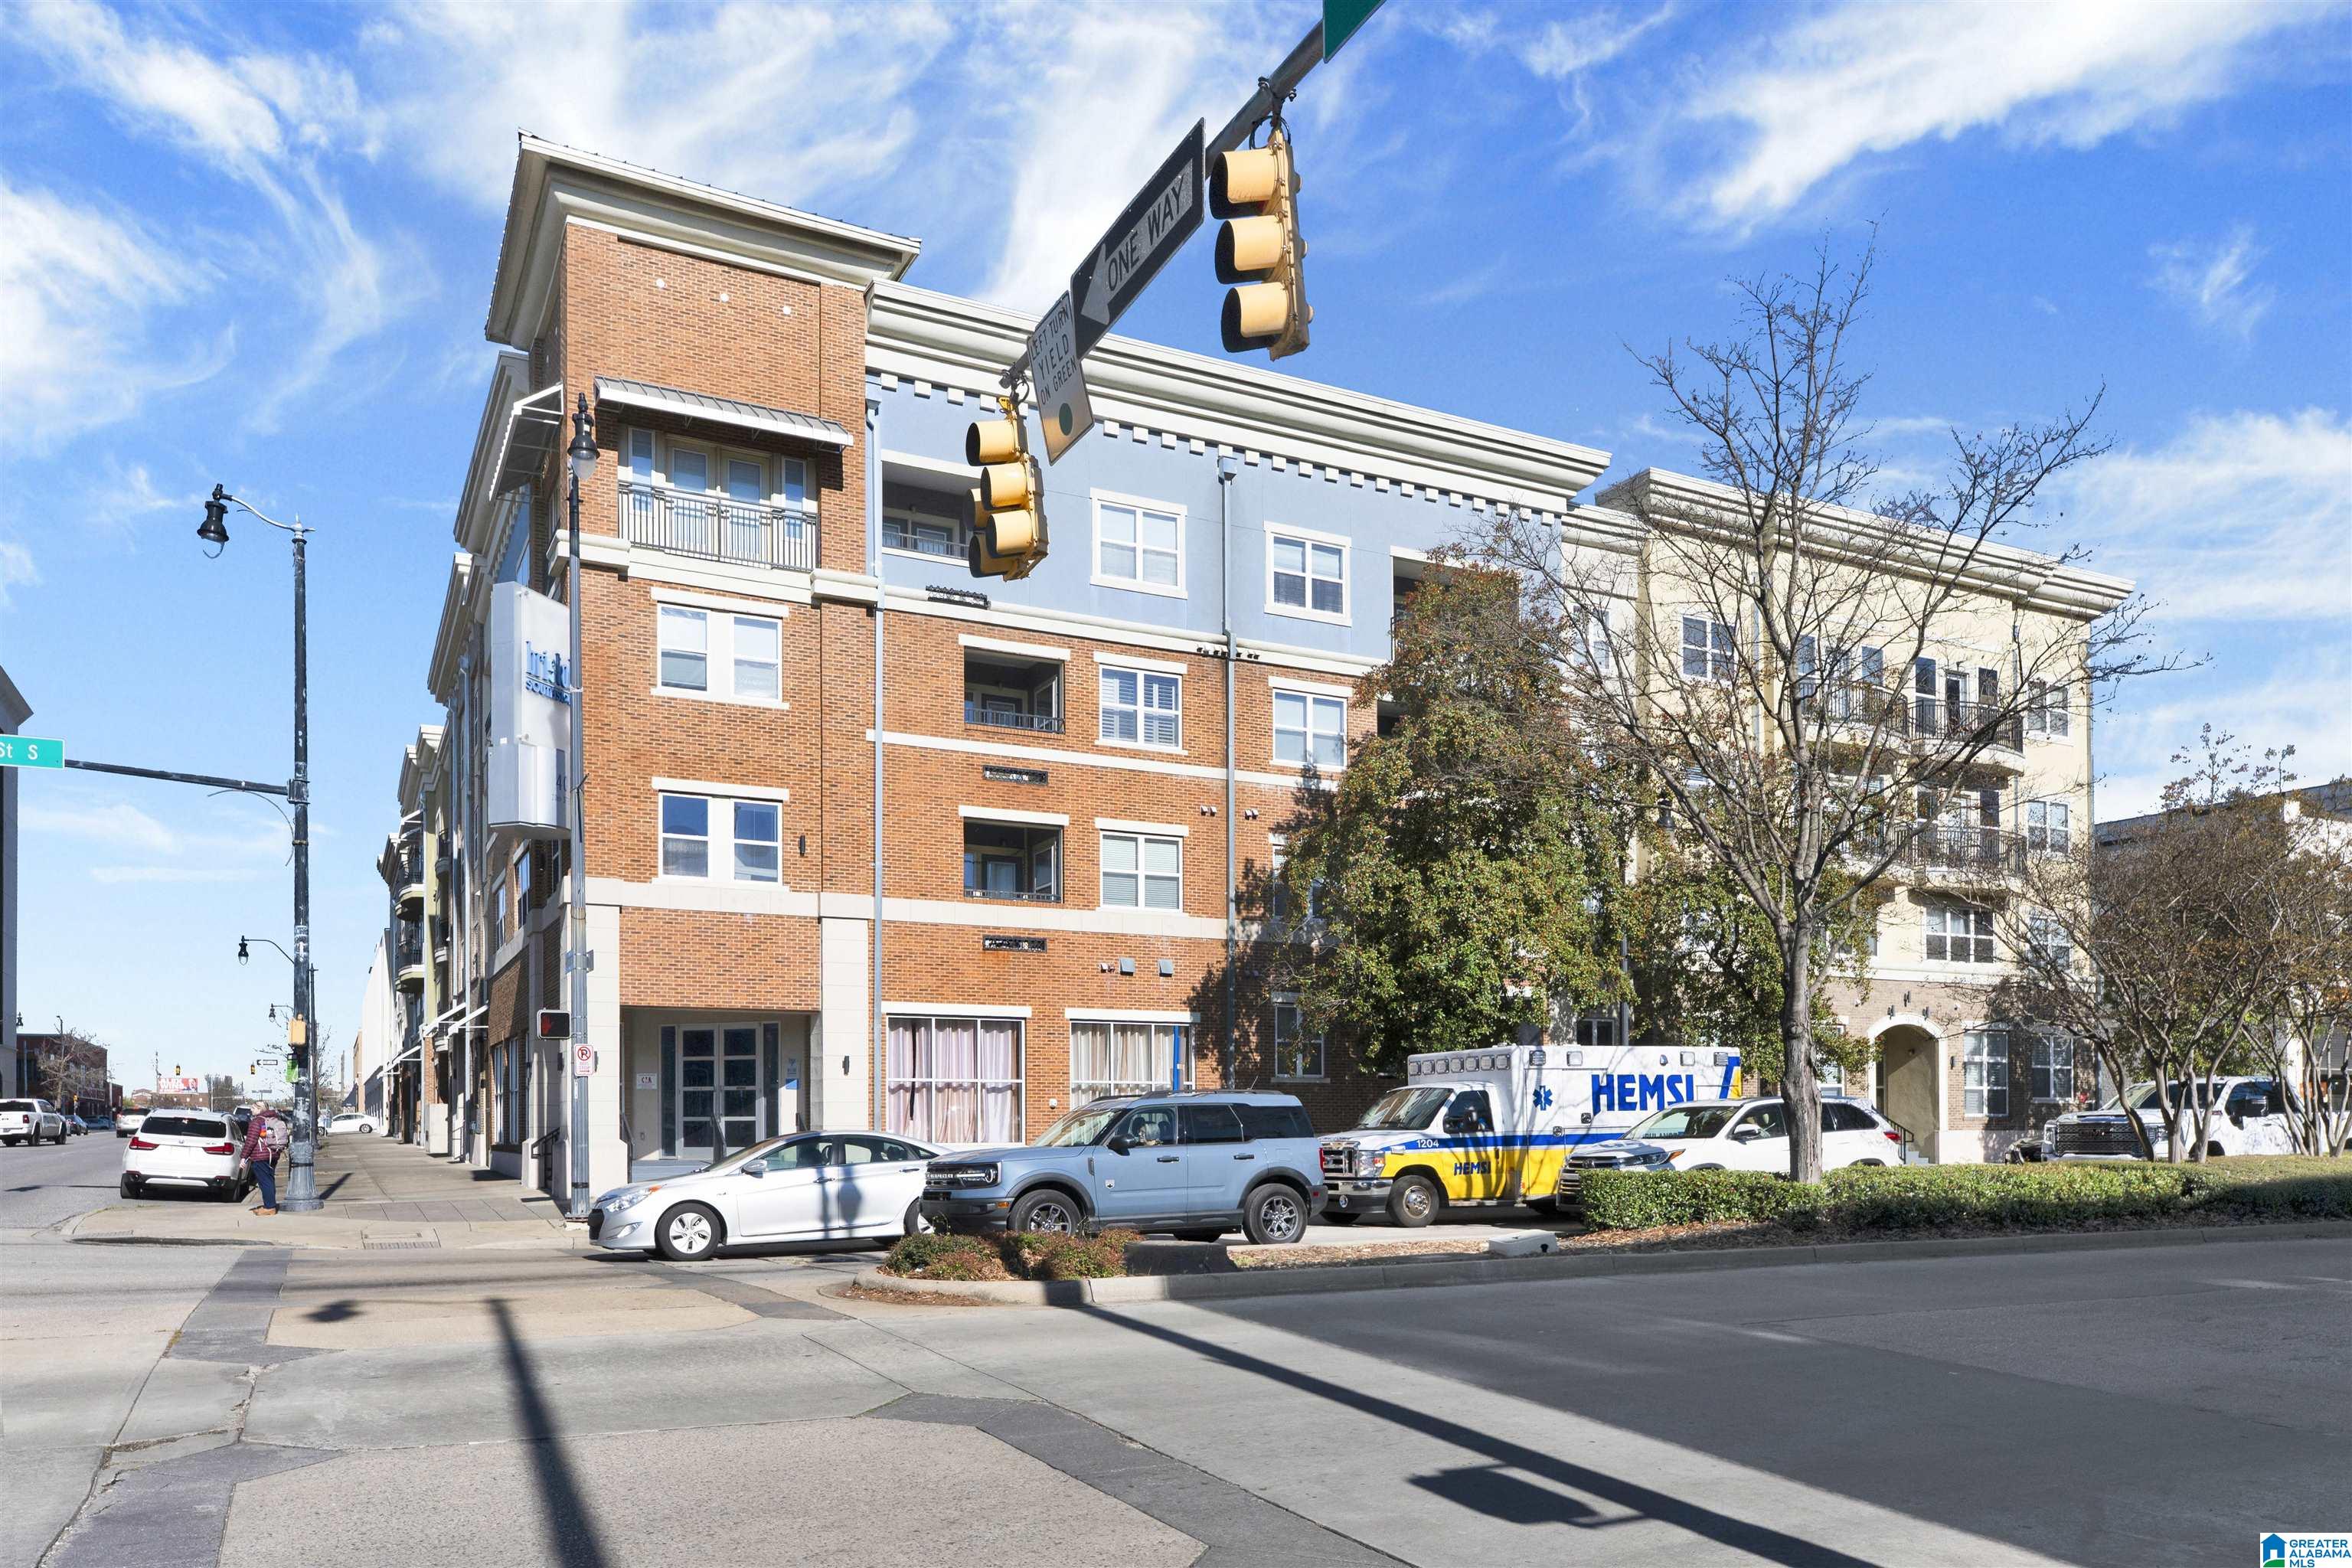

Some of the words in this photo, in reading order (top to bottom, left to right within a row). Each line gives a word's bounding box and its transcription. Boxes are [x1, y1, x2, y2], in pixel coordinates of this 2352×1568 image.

[1109, 230, 1140, 291] ONE
[1147, 174, 1184, 245] WAY
[1030, 329, 1047, 360] LEFT
[1049, 305, 1070, 338] TURN
[1038, 334, 1069, 380] YIELD
[1040, 385, 1051, 405] ON
[1053, 354, 1077, 392] GREEN
[0, 742, 13, 759] St
[28, 744, 38, 760] S
[1592, 1074, 1694, 1116] HEMSI
[1416, 1139, 1439, 1148] 1204
[1454, 1161, 1491, 1176] HEMSI
